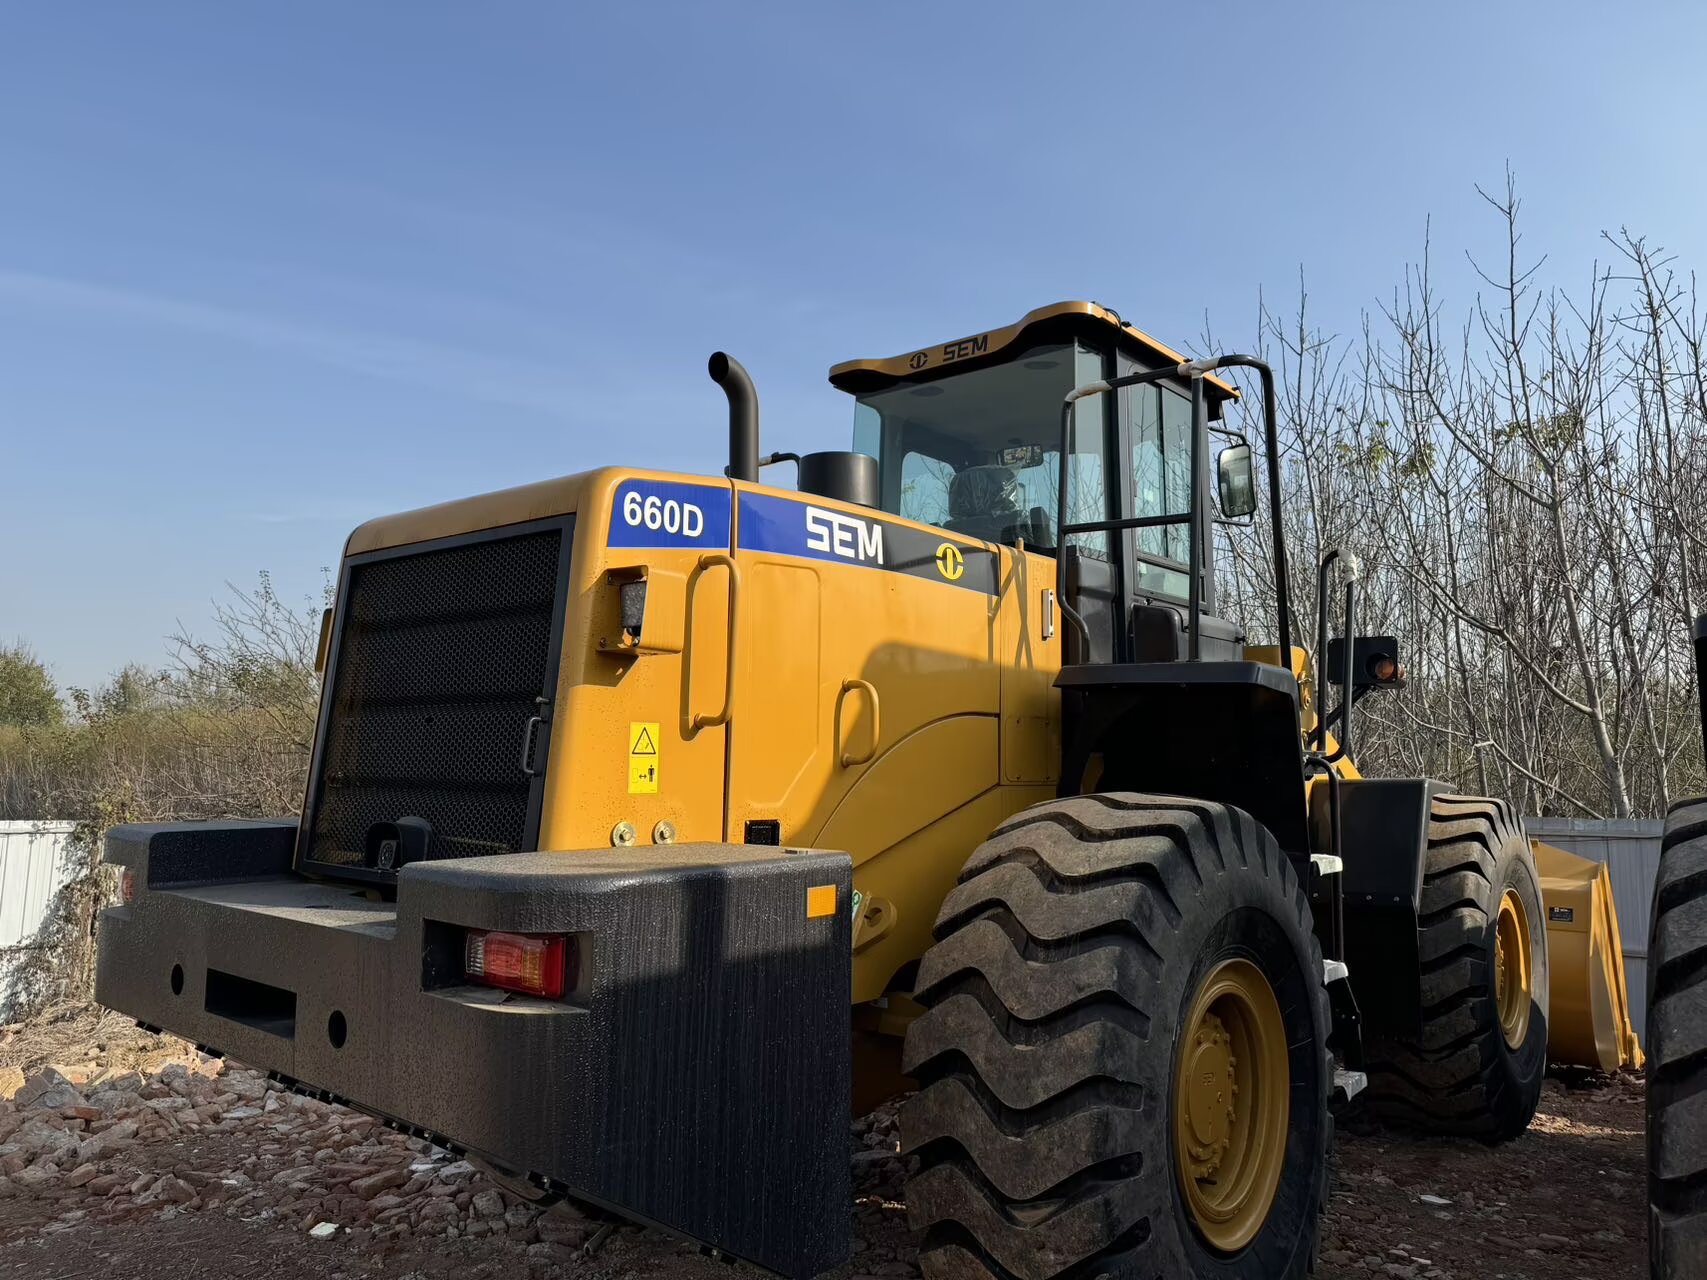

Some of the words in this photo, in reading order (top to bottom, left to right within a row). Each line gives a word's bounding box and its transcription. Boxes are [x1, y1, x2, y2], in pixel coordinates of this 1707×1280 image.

[943, 334, 988, 362] SEM
[623, 491, 704, 537] 660D
[805, 506, 884, 565] SEM
